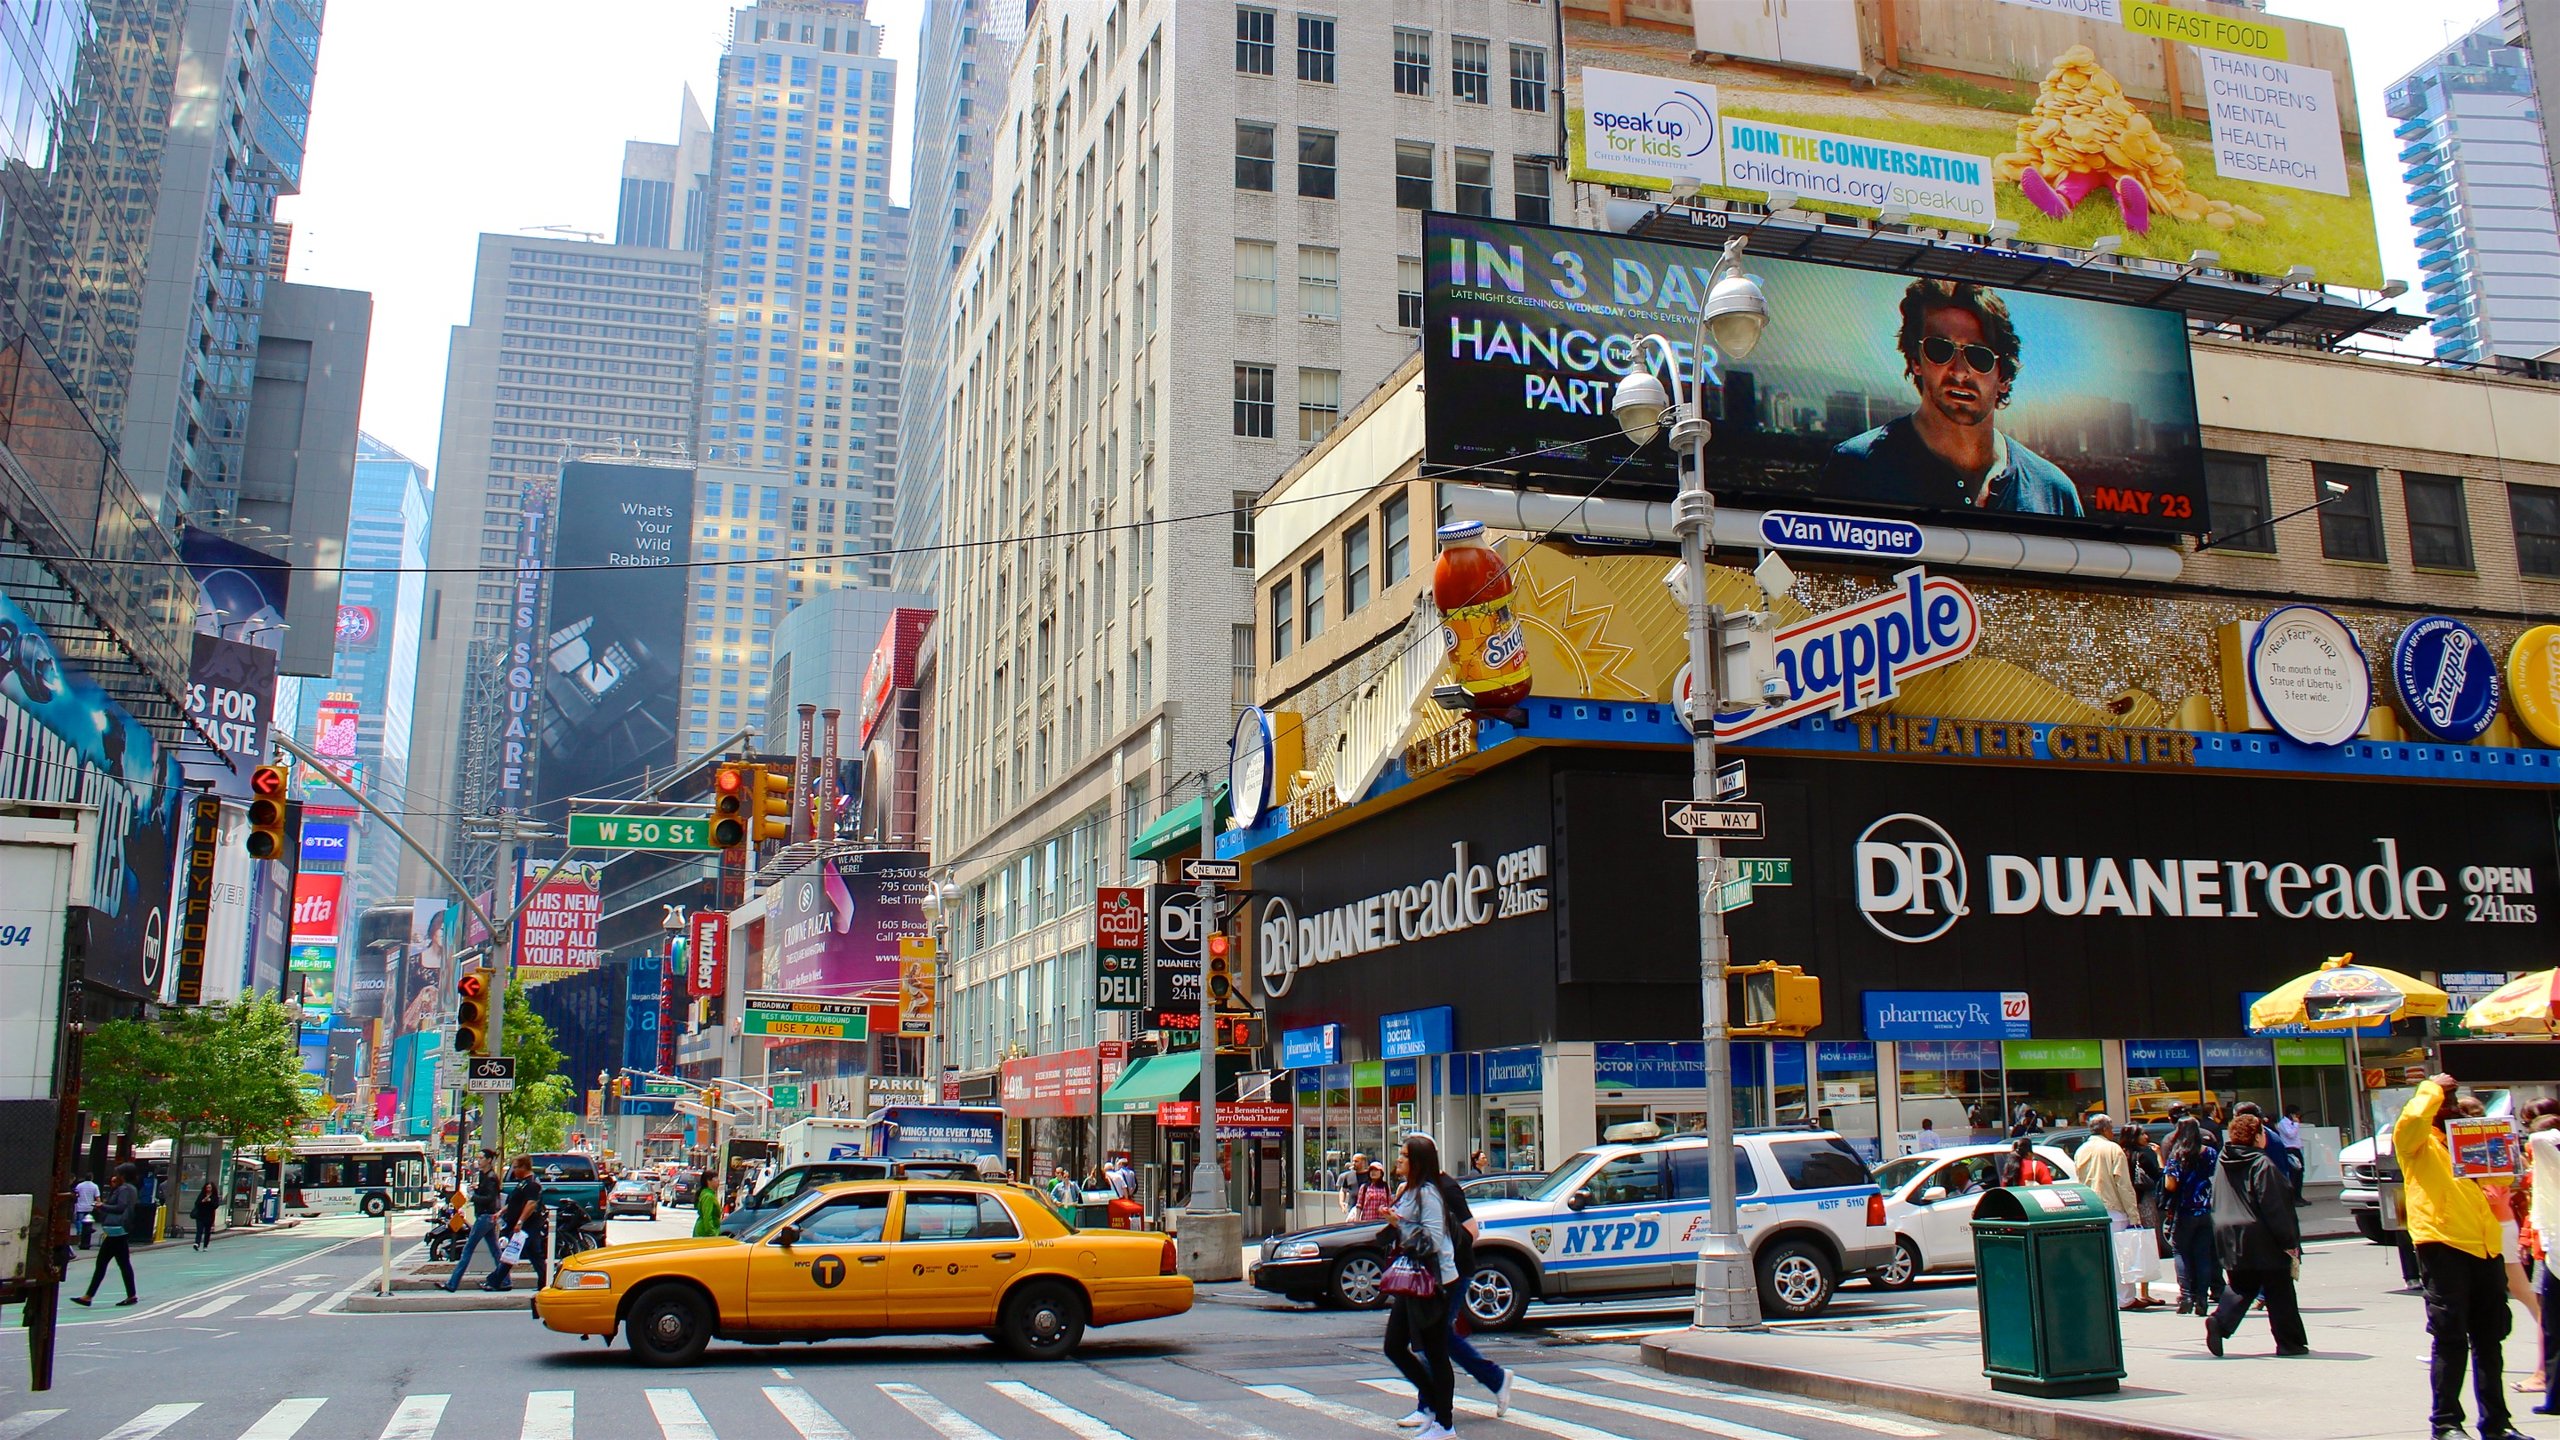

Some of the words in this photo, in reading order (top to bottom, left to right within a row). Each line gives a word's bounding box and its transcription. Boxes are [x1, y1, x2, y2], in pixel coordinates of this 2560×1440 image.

[2133, 7, 2161, 30] ON
[2167, 13, 2211, 39] FAST
[2216, 23, 2268, 49] FOOD
[2210, 56, 2257, 78] THAN
[2263, 63, 2288, 84] ON
[2213, 79, 2317, 112] CHILDREN'S
[2217, 103, 2286, 129] MENTAL
[1593, 111, 1653, 133] speak
[1657, 120, 1683, 141] up
[1607, 129, 1636, 152] for
[1642, 134, 1681, 158] kids
[2220, 127, 2287, 152] HEALTH
[2224, 150, 2317, 180] RESEARCH
[1733, 160, 1984, 218] childmind.org/speakup
[1691, 211, 1727, 229] M-120
[1450, 237, 1525, 293] IN
[1550, 250, 1588, 300] 3
[1451, 289, 1473, 300] LATE
[1474, 291, 1505, 303] NIGHT
[1506, 295, 1564, 310] SCREENINGS
[1566, 302, 1626, 318] WEDNESDAY,
[1628, 309, 1658, 321] OPENS
[1525, 374, 1608, 416] PART
[621, 503, 673, 518] What's
[2095, 487, 2154, 515] MAY
[2160, 494, 2193, 519] 23
[636, 520, 672, 535] Your
[1779, 517, 1822, 541] Van
[1829, 520, 1914, 550] Wagner
[635, 537, 671, 552] Wild
[609, 553, 671, 567] Rabbit?
[516, 512, 544, 628] TIMES
[2313, 635, 2337, 660] #202
[2405, 646, 2414, 673] STUFF
[2272, 663, 2286, 674] The
[2288, 665, 2311, 675] mouth
[2313, 666, 2322, 676] of
[2324, 667, 2337, 677] the
[2426, 630, 2469, 725] Snapple
[2269, 677, 2293, 688] Statue
[2296, 678, 2306, 688] of
[2307, 678, 2333, 691] Liberty
[2335, 681, 2343, 690] is
[2408, 674, 2417, 694] BEST
[211, 687, 257, 722] FOR
[328, 692, 353, 701] 2013
[2284, 690, 2289, 700] 3
[2291, 690, 2308, 701] feet
[2310, 691, 2330, 702] wide.
[2412, 696, 2424, 713] THE
[503, 642, 532, 790] SQUARE
[1852, 714, 2036, 758] THEATER
[2047, 722, 2198, 765] CENTER
[1722, 775, 1736, 791] WAY
[1680, 812, 1707, 826] ONE
[1721, 813, 1750, 827] WAY
[599, 823, 618, 842] W
[627, 824, 660, 842] 50
[668, 825, 695, 844] St
[315, 838, 344, 847] TDK
[838, 856, 848, 864] WE
[849, 855, 863, 863] ARE
[1497, 845, 1547, 885] OPEN
[840, 864, 860, 873] HERE!
[1193, 866, 1210, 874] ONE
[1214, 866, 1232, 875] WAY
[1742, 861, 1752, 876] W
[1757, 862, 1773, 882] 50
[1777, 863, 1788, 872] ST
[2461, 865, 2532, 896] OPEN
[528, 893, 561, 909] THIS
[565, 894, 599, 911] NEW
[1103, 901, 1118, 912] ny
[1498, 883, 1548, 919] 24hrs
[2464, 895, 2538, 924] 24hrs
[526, 911, 577, 928] WATCH
[877, 921, 898, 929] 1605
[1100, 906, 1141, 933] nail
[525, 929, 565, 946] DROP
[876, 933, 893, 941] Call
[1113, 935, 1138, 947] land
[524, 947, 563, 965] YOUR
[1121, 958, 1137, 969] EZ
[2442, 974, 2465, 985] COSMIC
[2466, 974, 2485, 985] CANDY
[2486, 974, 2505, 984] STORE
[1100, 976, 1140, 1003] DELI
[752, 1001, 790, 1010] BROADWAY
[793, 1003, 820, 1011] CLOSED
[834, 1005, 840, 1013] W
[852, 1006, 861, 1014] ST
[1879, 1003, 1967, 1029] pharmacy
[1968, 1003, 1990, 1025] Rx
[761, 1012, 778, 1020] BEST
[781, 1013, 801, 1022] ROUTE
[805, 1015, 851, 1024] SOUTHBOUND
[775, 1023, 796, 1033] USE
[802, 1025, 808, 1034] 7
[814, 1025, 834, 1035] AVE
[1387, 1029, 1411, 1043] DOCTOR
[2262, 1024, 2282, 1035] ON
[1287, 1040, 1313, 1060] pharmacy
[1387, 1045, 1397, 1055] ON
[1398, 1040, 1425, 1055] PREMISES
[2019, 1050, 2048, 1061] WHAT
[2057, 1049, 2086, 1060] NEED
[2132, 1049, 2155, 1060] HOW
[2166, 1049, 2190, 1059] FEEL
[2207, 1048, 2230, 1058] HOW
[1820, 1053, 1840, 1061] HOW
[1915, 1052, 1940, 1061] HOW
[1488, 1059, 1535, 1087] pharmacy
[1636, 1062, 1652, 1072] ON
[471, 1080, 488, 1089] BIKE
[491, 1080, 512, 1089] PATH
[1235, 1106, 1264, 1114] Bernstein
[1265, 1106, 1288, 1114] Theater
[1216, 1115, 1232, 1123] Jerry
[900, 1126, 927, 1136] WINGS
[929, 1127, 944, 1137] FOR
[946, 1128, 969, 1138] EVERY
[971, 1128, 993, 1138] TASTE.
[1817, 1199, 1840, 1211] MSTF
[1846, 1197, 1865, 1208] 5110
[1562, 1221, 1660, 1253] NYPD
[819, 1261, 839, 1285] T
